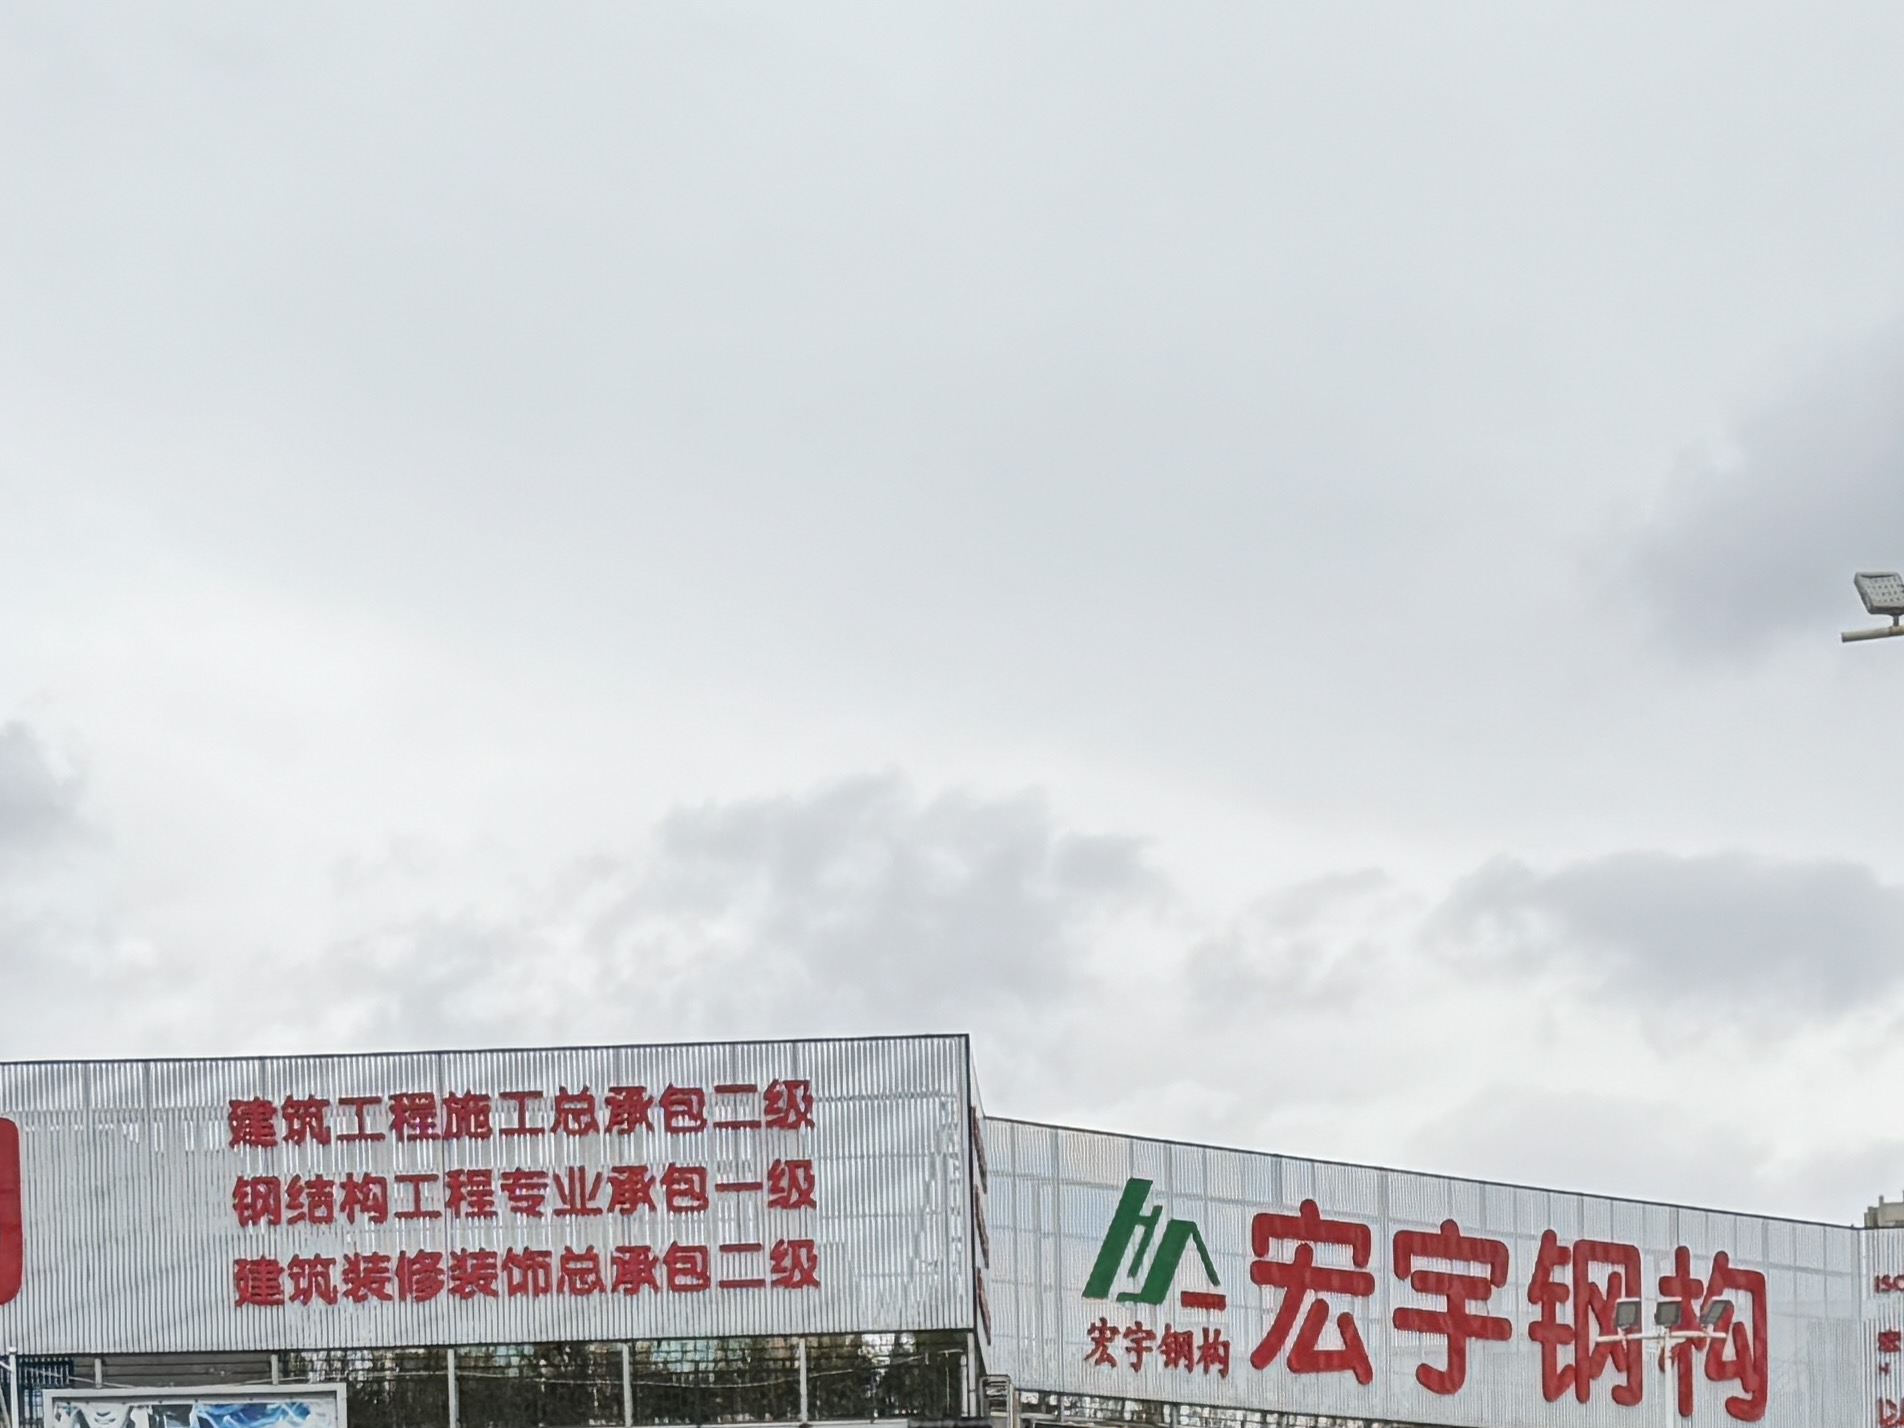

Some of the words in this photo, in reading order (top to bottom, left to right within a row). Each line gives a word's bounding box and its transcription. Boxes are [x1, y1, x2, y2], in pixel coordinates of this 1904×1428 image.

[229, 1079, 815, 1149] 建筑工程施工总承包二级
[233, 1159, 817, 1227] 钢结构工程专业承包一级
[234, 1238, 820, 1309] 建筑装修装饰总承包二级
[1250, 1200, 1770, 1422] 宏宇钢构
[1084, 1317, 1231, 1379] 宏宇钢构
